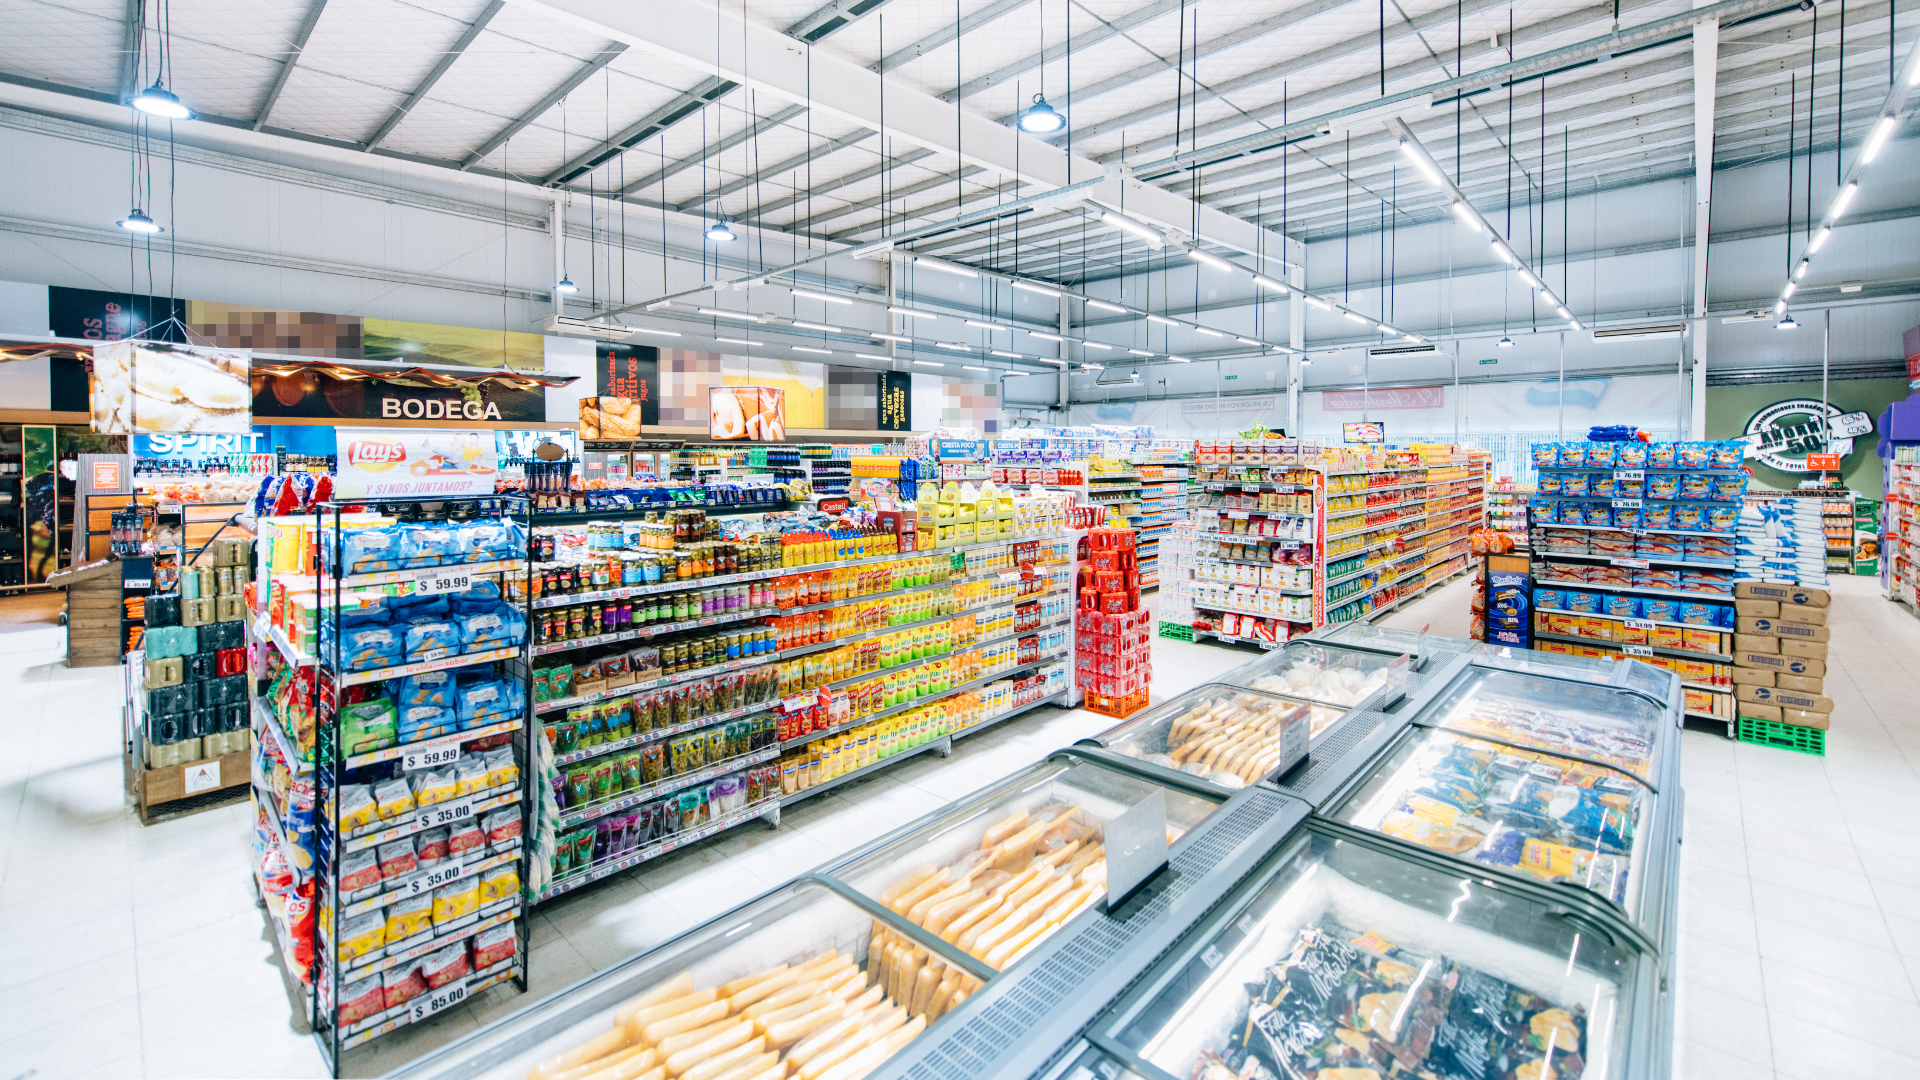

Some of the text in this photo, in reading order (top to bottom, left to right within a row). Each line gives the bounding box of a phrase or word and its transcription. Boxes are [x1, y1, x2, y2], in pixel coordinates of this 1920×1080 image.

[626, 357, 638, 398] ritivos
[382, 398, 502, 421] BODEGA
[149, 433, 264, 453] SPIRIT
[822, 503, 846, 512] Castell
[420, 576, 469, 592] $ 59.99
[406, 665, 414, 673] la
[415, 664, 433, 673] vida
[445, 658, 470, 667] sabor
[407, 749, 457, 767] $ 59.99
[421, 805, 470, 828] $ 35.00
[411, 867, 460, 893] $ 35.00
[417, 944, 436, 956] vida
[447, 929, 472, 943] sabor
[414, 987, 464, 1019] $ 85.00
